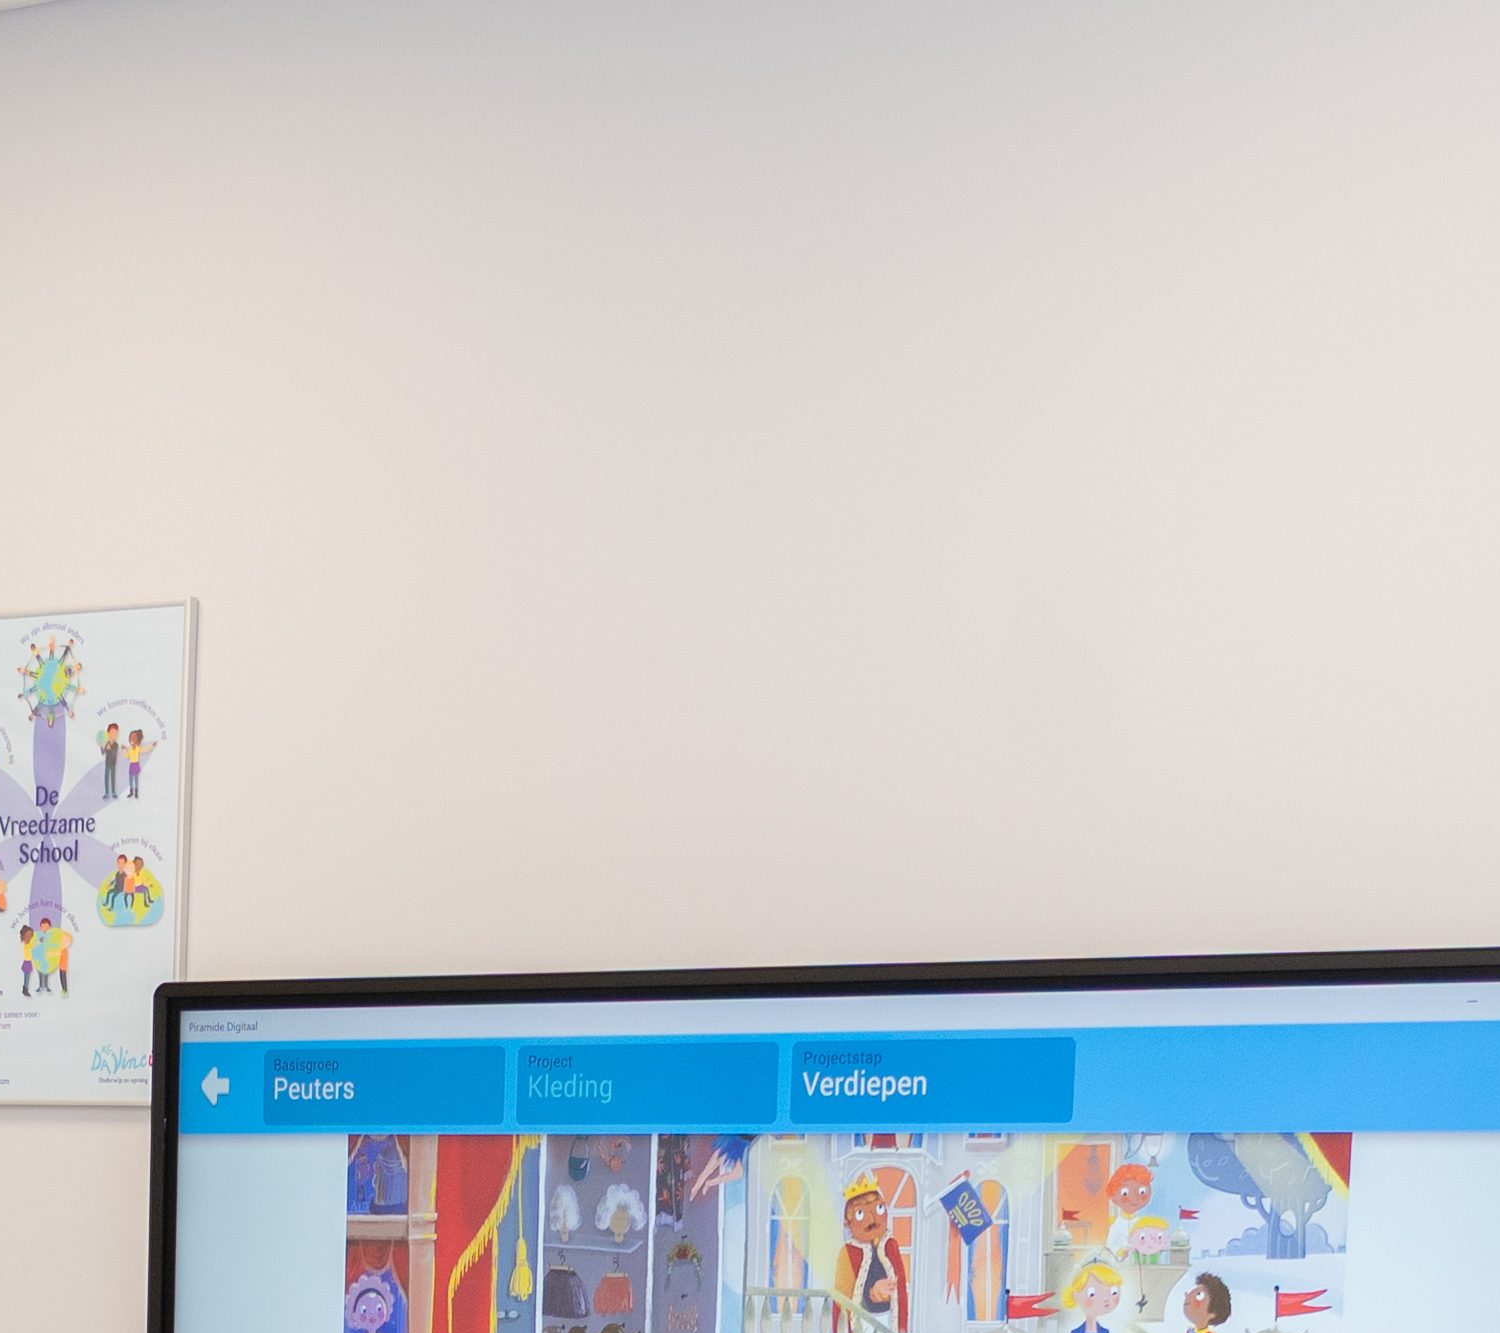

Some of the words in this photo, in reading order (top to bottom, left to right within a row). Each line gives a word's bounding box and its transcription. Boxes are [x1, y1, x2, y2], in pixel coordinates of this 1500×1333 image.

[36, 786, 59, 807] De
[0, 813, 96, 836] Vreedzame
[19, 839, 79, 864] School
[189, 1022, 225, 1032] Piramide
[227, 1021, 259, 1034] Digitaal
[274, 1058, 339, 1074] Basisgroep
[527, 1055, 573, 1071] Project
[803, 1051, 882, 1068] Projectstap
[273, 1076, 355, 1100] Peuters
[527, 1073, 613, 1103] Kleding
[803, 1070, 929, 1102] Verdiepen
